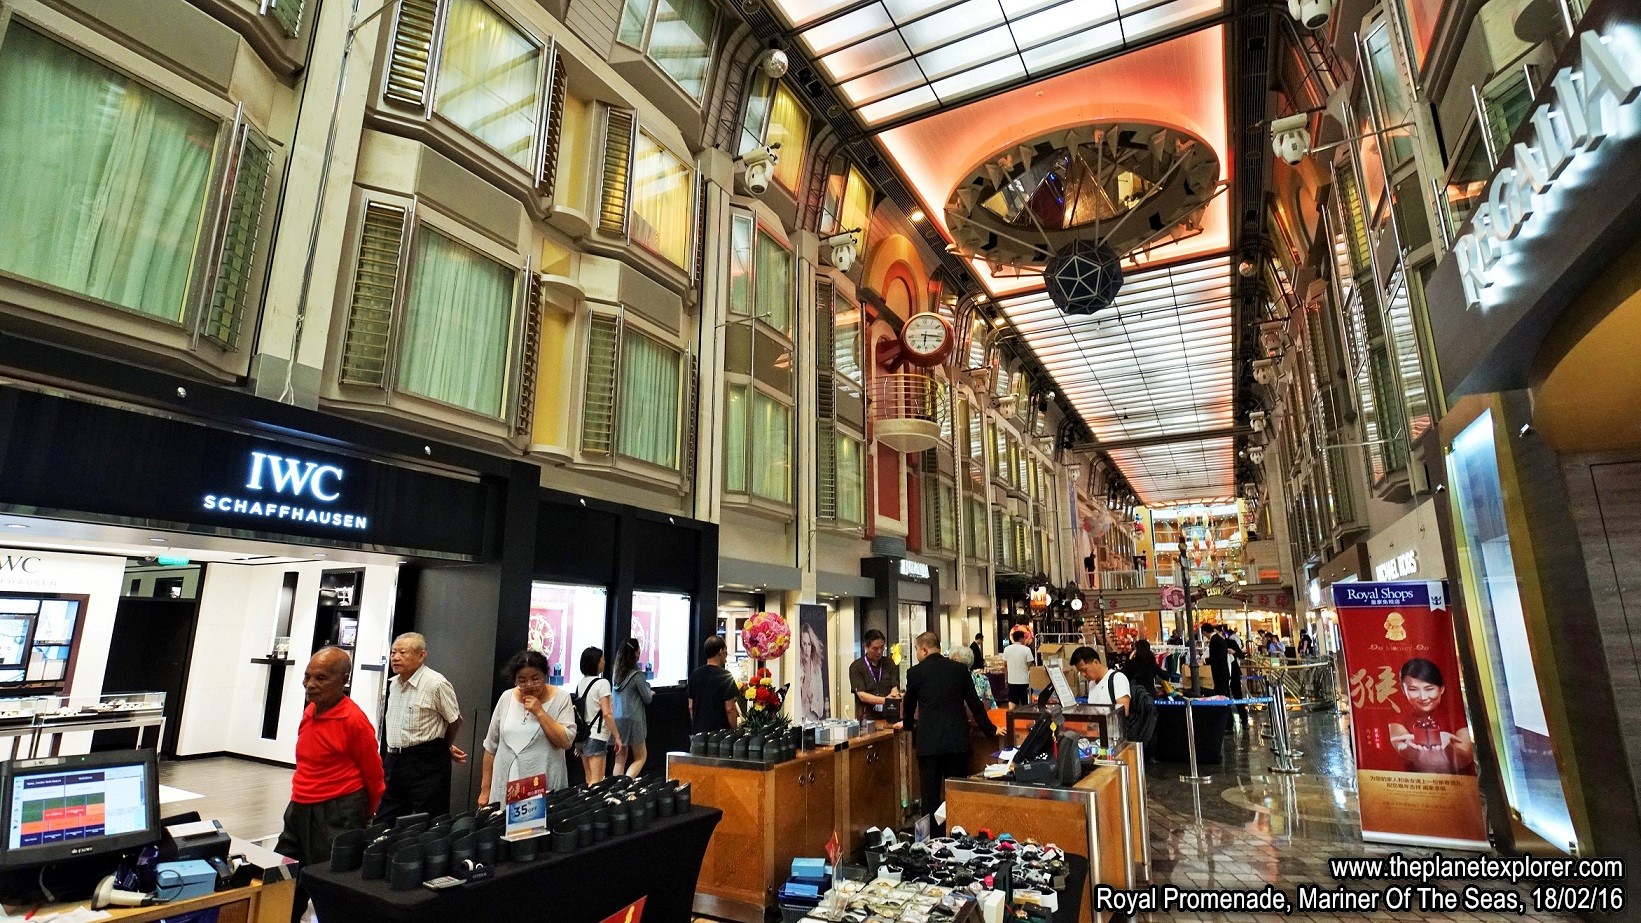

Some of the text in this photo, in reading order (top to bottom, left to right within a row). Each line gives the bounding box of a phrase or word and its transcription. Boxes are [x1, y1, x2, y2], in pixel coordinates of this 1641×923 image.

[1453, 29, 1641, 310] REGALIA
[246, 451, 343, 500] IWC
[203, 494, 367, 530] SCHAFFHAUSEN
[1347, 587, 1414, 602] Royal Shops
